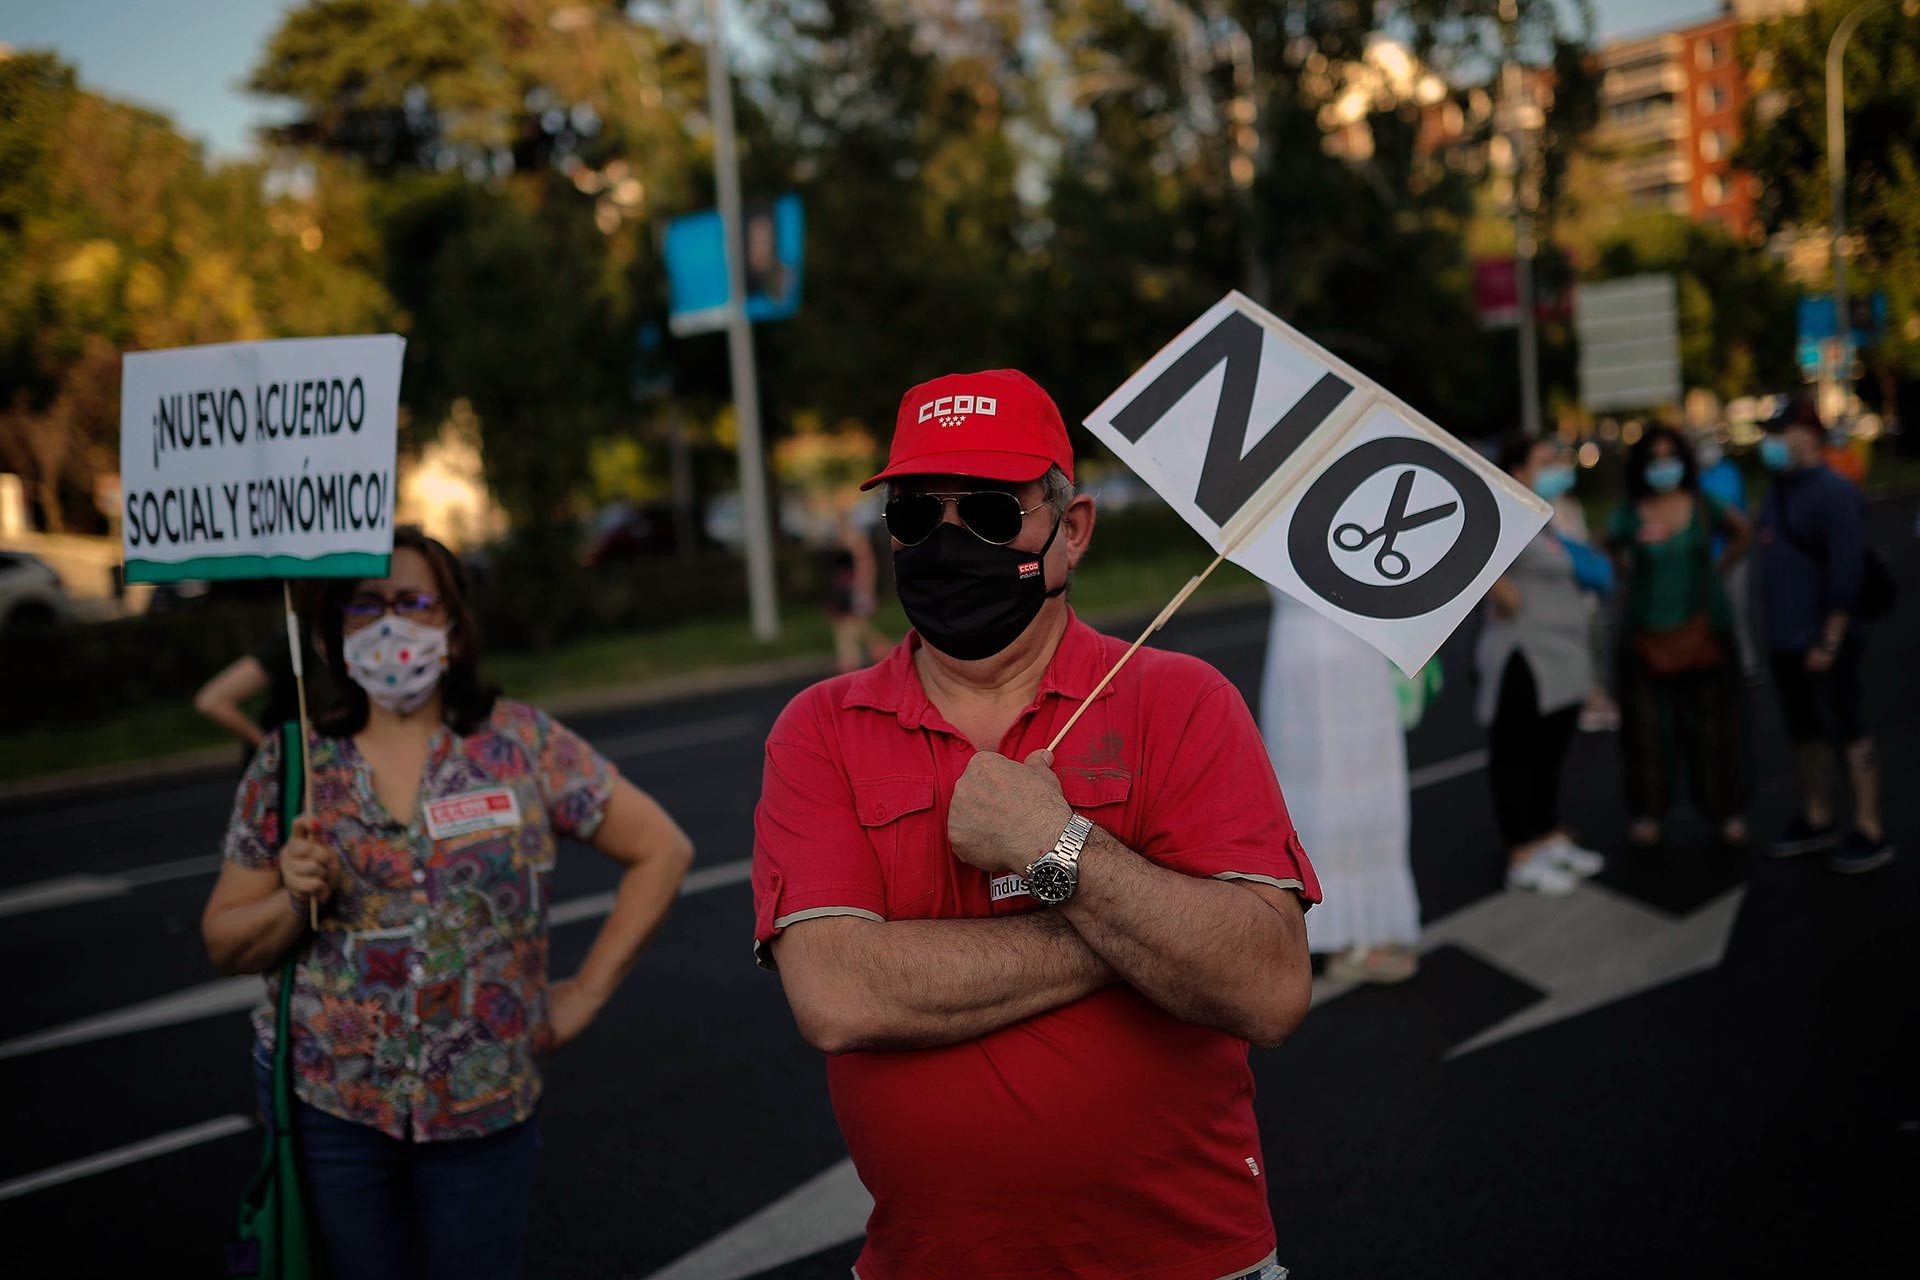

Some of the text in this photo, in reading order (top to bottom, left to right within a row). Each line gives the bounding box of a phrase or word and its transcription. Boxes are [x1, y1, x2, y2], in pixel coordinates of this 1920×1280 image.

[152, 376, 365, 470] ¡NUEVO ACUERDO
[917, 395, 997, 424] CCOO
[1108, 309, 1501, 619] NO
[127, 456, 388, 547] SOCIAL Y ECONÓMICO!
[1019, 562, 1039, 573] CCOO
[991, 877, 1030, 899] indus
